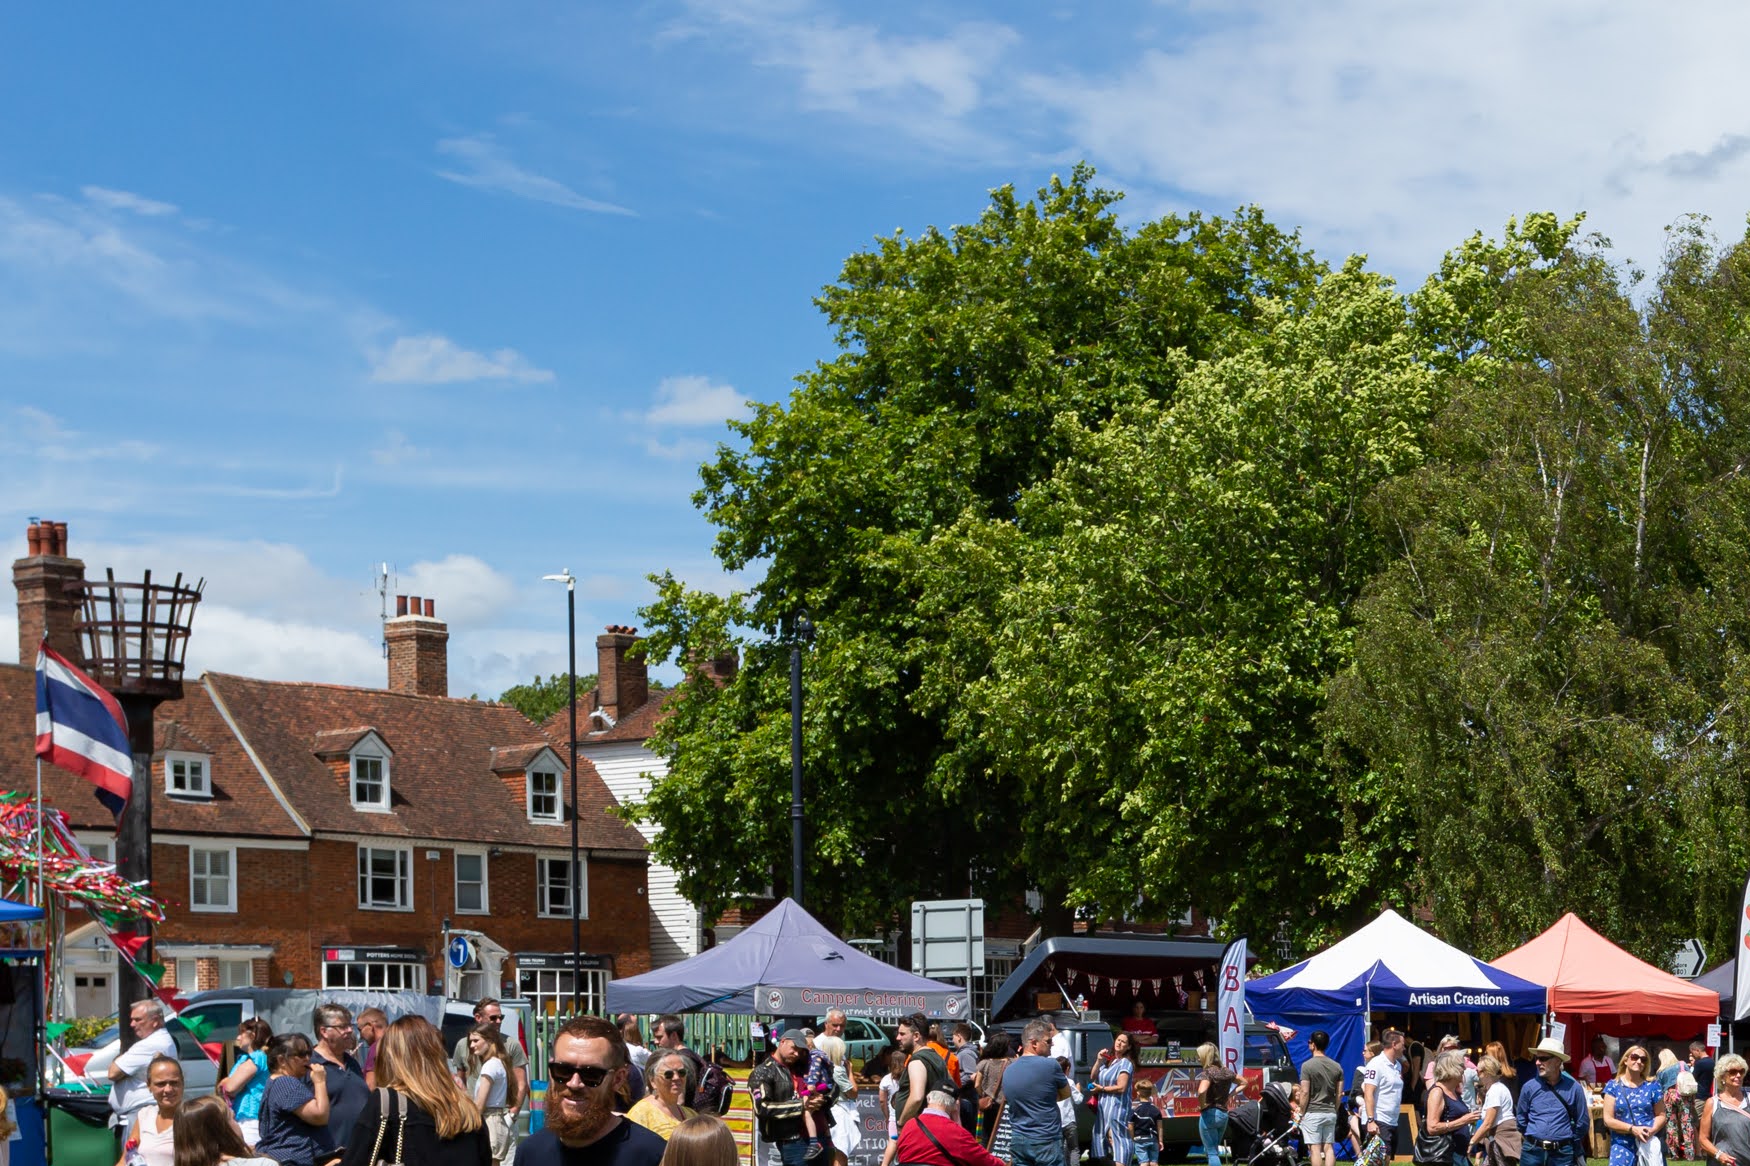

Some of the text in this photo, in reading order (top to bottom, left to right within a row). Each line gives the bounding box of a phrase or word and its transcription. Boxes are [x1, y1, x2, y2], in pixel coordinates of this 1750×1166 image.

[801, 989, 926, 1010] Camper Catering
[1409, 992, 1510, 1006] Artisan Creations
[877, 1007, 903, 1017] Grill
[1223, 966, 1240, 1075] BAR
[1365, 1070, 1376, 1079] 28
